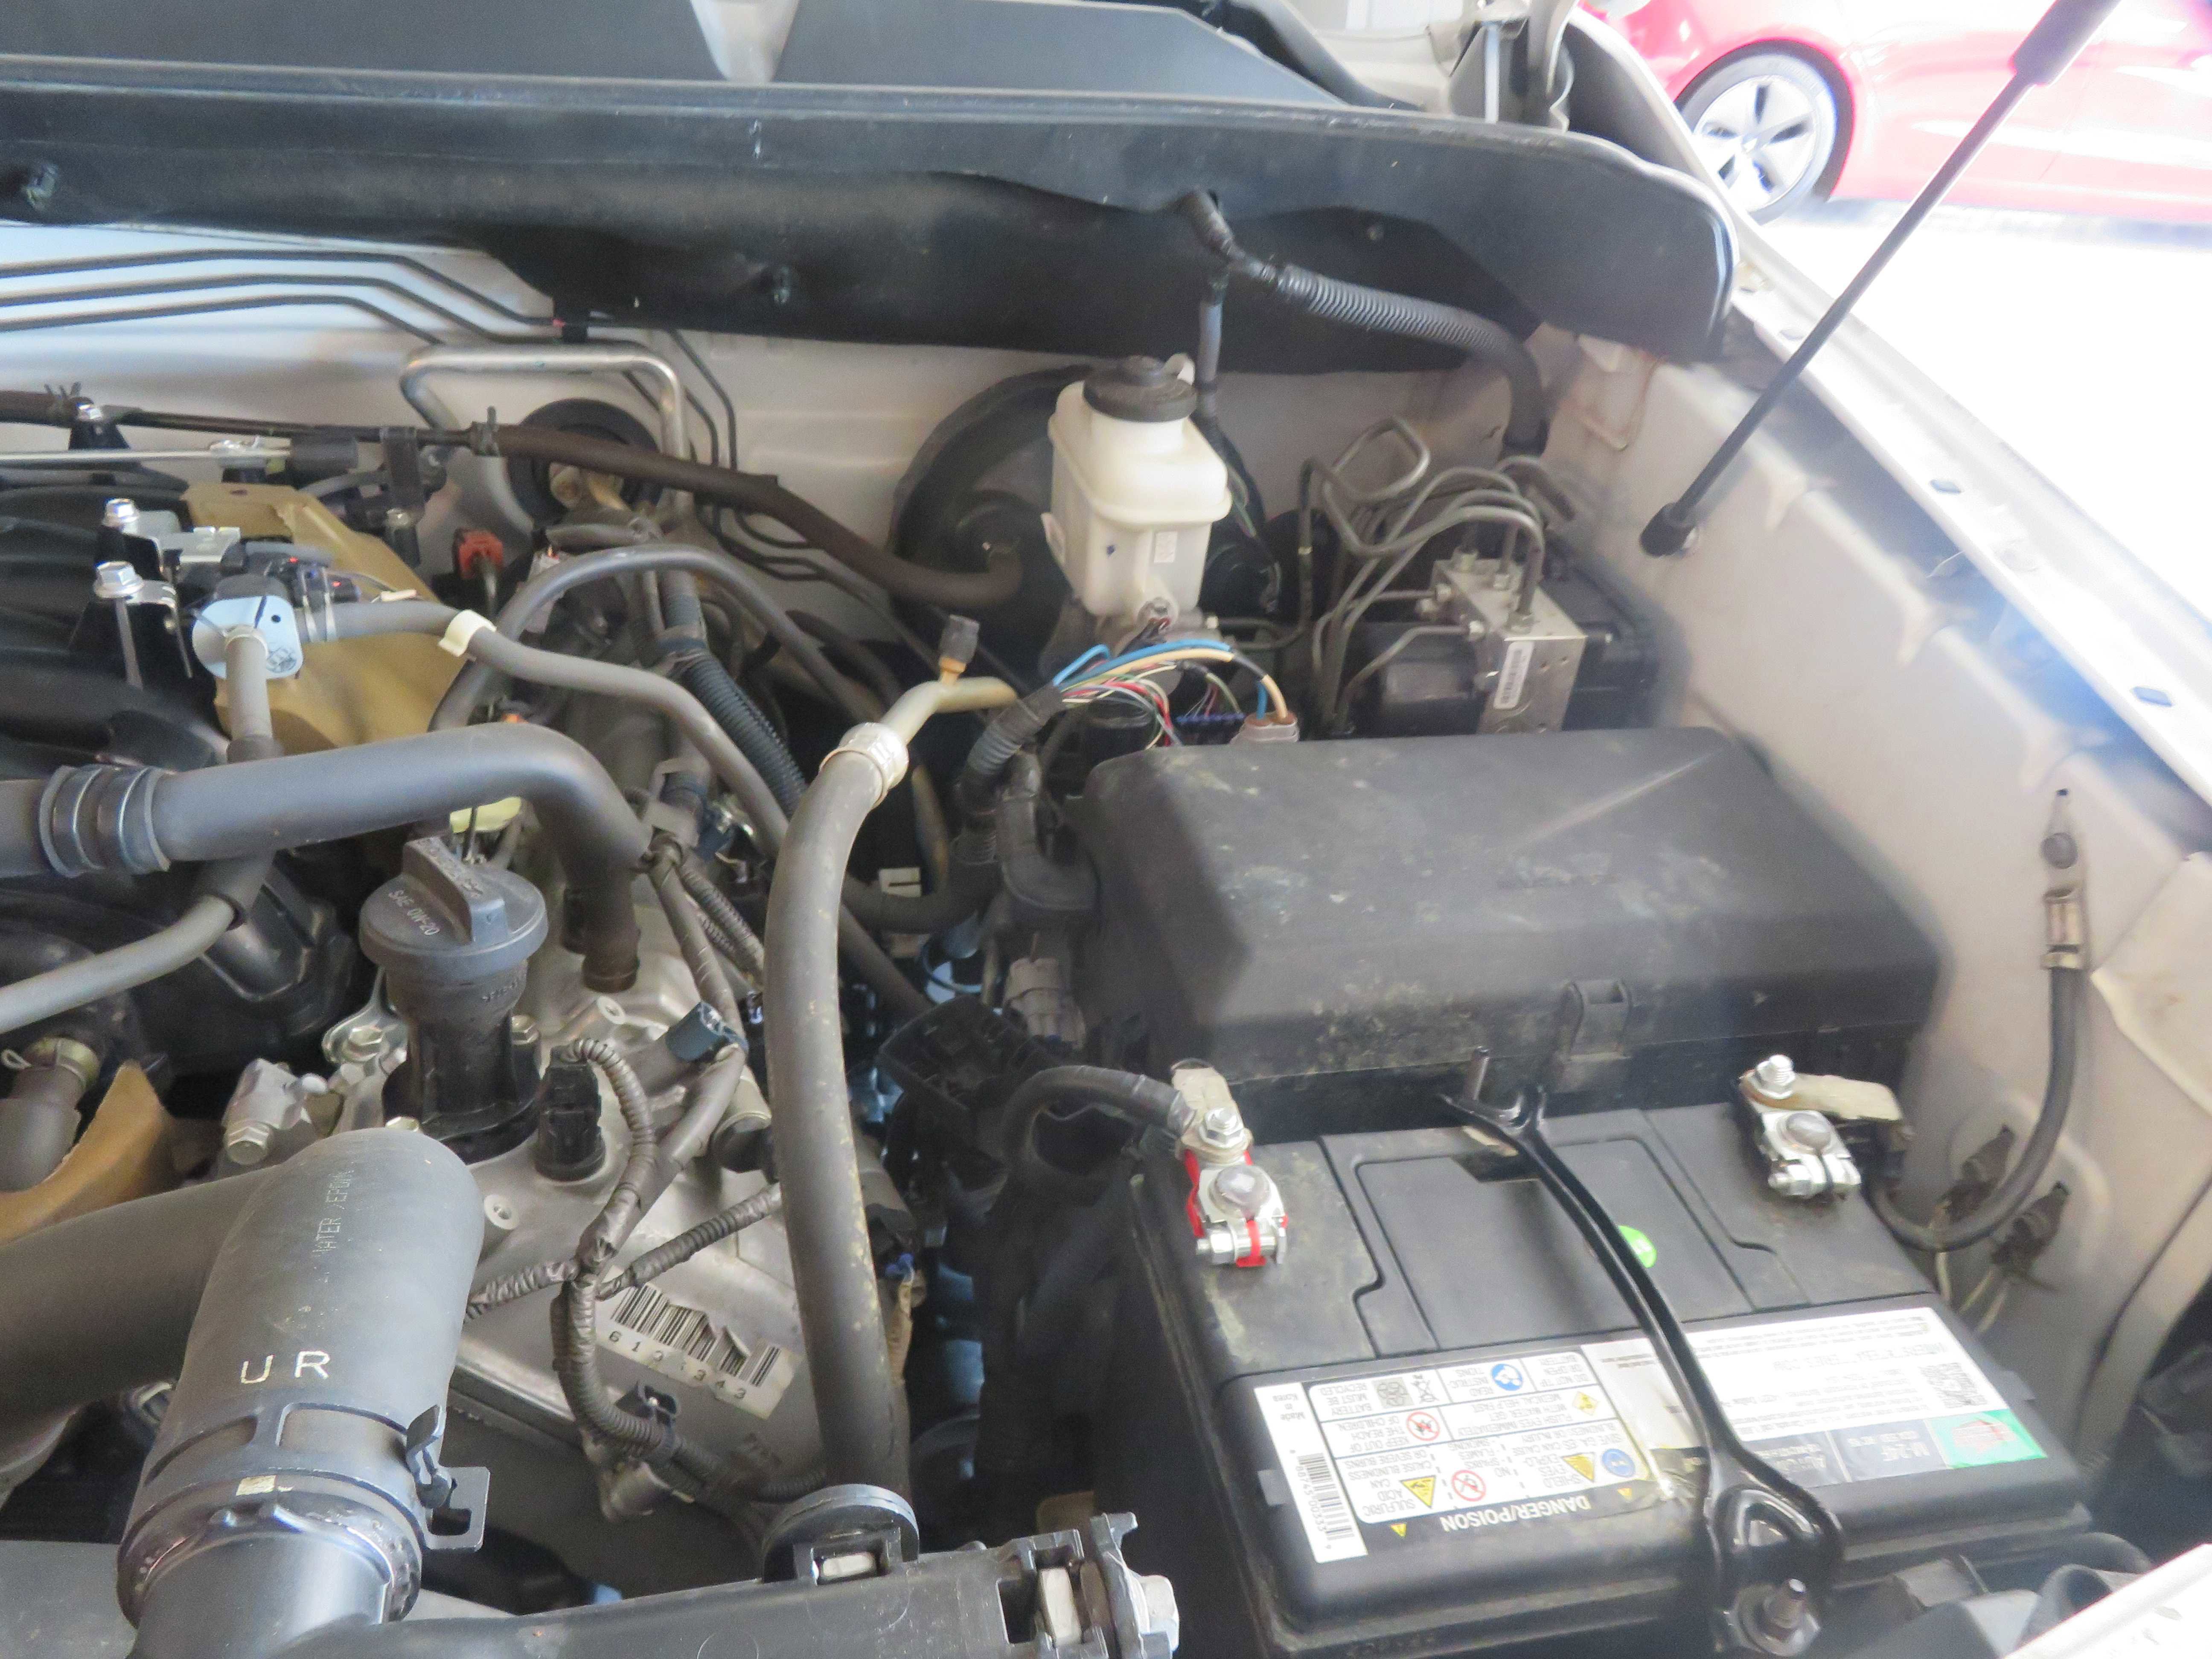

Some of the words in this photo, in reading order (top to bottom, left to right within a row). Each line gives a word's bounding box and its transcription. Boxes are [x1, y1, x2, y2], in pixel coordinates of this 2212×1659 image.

[389, 890, 414, 906] SAE
[241, 1354, 275, 1384] U
[294, 1350, 330, 1380] R
[1271, 1392, 1299, 1403] Korea
[1325, 1396, 1340, 1406] BE
[1339, 1392, 1369, 1404] MUST
[1329, 1402, 1374, 1416] BATTERY
[1279, 1411, 1306, 1422] Made
[1385, 1415, 1401, 1425] OF
[1349, 1428, 1385, 1441] REACH
[1383, 1425, 1406, 1436] THE
[1346, 1442, 1363, 1453] OF
[1362, 1439, 1385, 1451] OUT
[1383, 1435, 1411, 1448] KEEP
[1368, 1478, 1392, 1489] CAN
[1375, 1488, 1405, 1502] ACID
[1360, 1498, 1417, 1517] SULFURIC
[1439, 1493, 1592, 1532] DANGER/POISON
